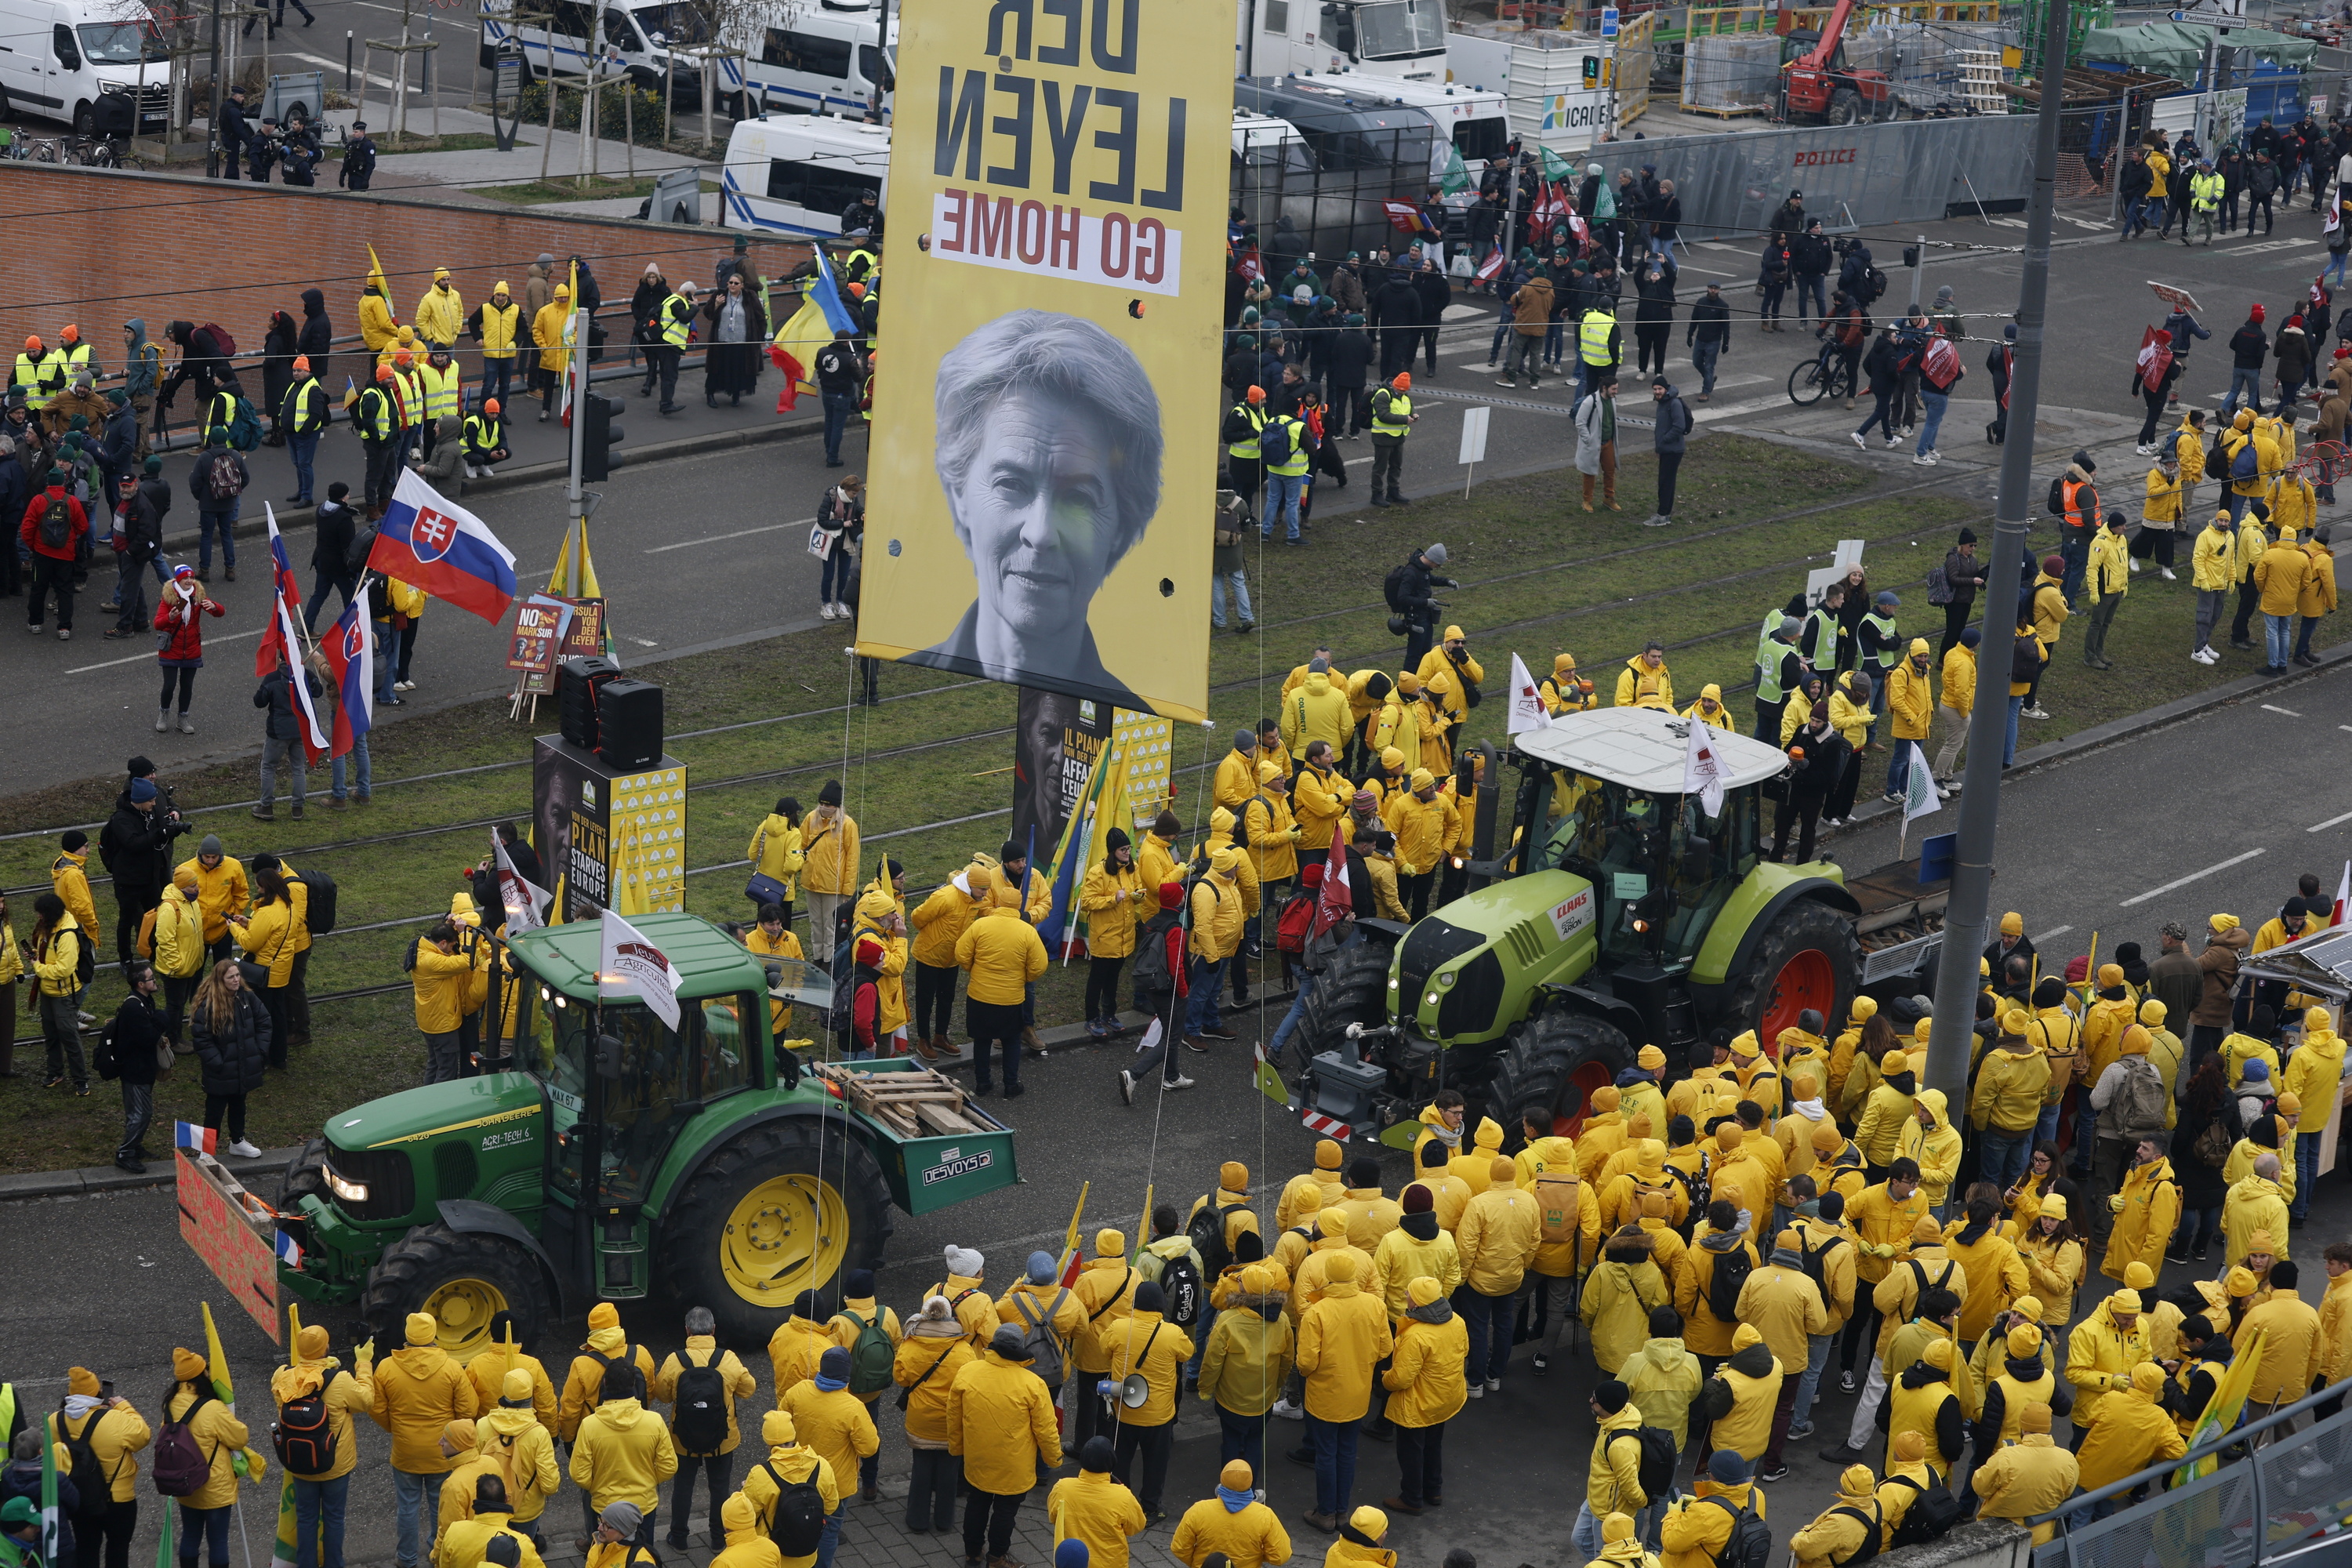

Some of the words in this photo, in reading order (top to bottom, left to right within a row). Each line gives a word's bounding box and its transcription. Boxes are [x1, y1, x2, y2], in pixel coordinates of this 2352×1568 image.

[1604, 18, 1617, 27] TAXIS
[2184, 14, 2215, 24] Parlement
[2216, 17, 2244, 27] Européen
[1794, 148, 1857, 167] POLICE
[283, 165, 295, 173] CRS
[518, 608, 539, 627] NO
[573, 606, 598, 617] RSULA
[582, 616, 597, 626] VON
[516, 626, 553, 638] MARKSUR
[571, 635, 596, 646] LEYEN
[581, 626, 597, 636] DER
[1298, 697, 1306, 733] COLDIRETTI
[1065, 727, 1073, 746] IL
[1063, 745, 1075, 758] VON
[1076, 750, 1088, 764] DER
[1062, 757, 1093, 782] AFFA
[571, 810, 581, 824] VON
[581, 814, 589, 828] DER
[590, 821, 606, 838] LEYEN'S
[572, 821, 605, 864] PLAN
[571, 848, 606, 884] STARVES
[572, 866, 606, 902] EUROPE
[1557, 892, 1587, 920] CLAAS
[1561, 916, 1575, 930] 650
[1563, 917, 1582, 935] ARION
[624, 957, 673, 998] Agriculteu
[552, 1089, 564, 1103] MAX
[566, 1094, 574, 1107] 67
[477, 1118, 502, 1128] JOHN
[501, 1109, 533, 1123] DEERE
[408, 1132, 430, 1142] 6420
[482, 1130, 522, 1148] AGRI-TECH
[524, 1127, 529, 1138] 6
[925, 1156, 978, 1184] DESVOYS
[176, 1152, 227, 1229] DEMAIN
[238, 1219, 269, 1271] NOUS
[180, 1219, 222, 1276] ENCORE
[226, 1261, 277, 1334] EXISTER
[1176, 1283, 1194, 1322] Carlsberg
